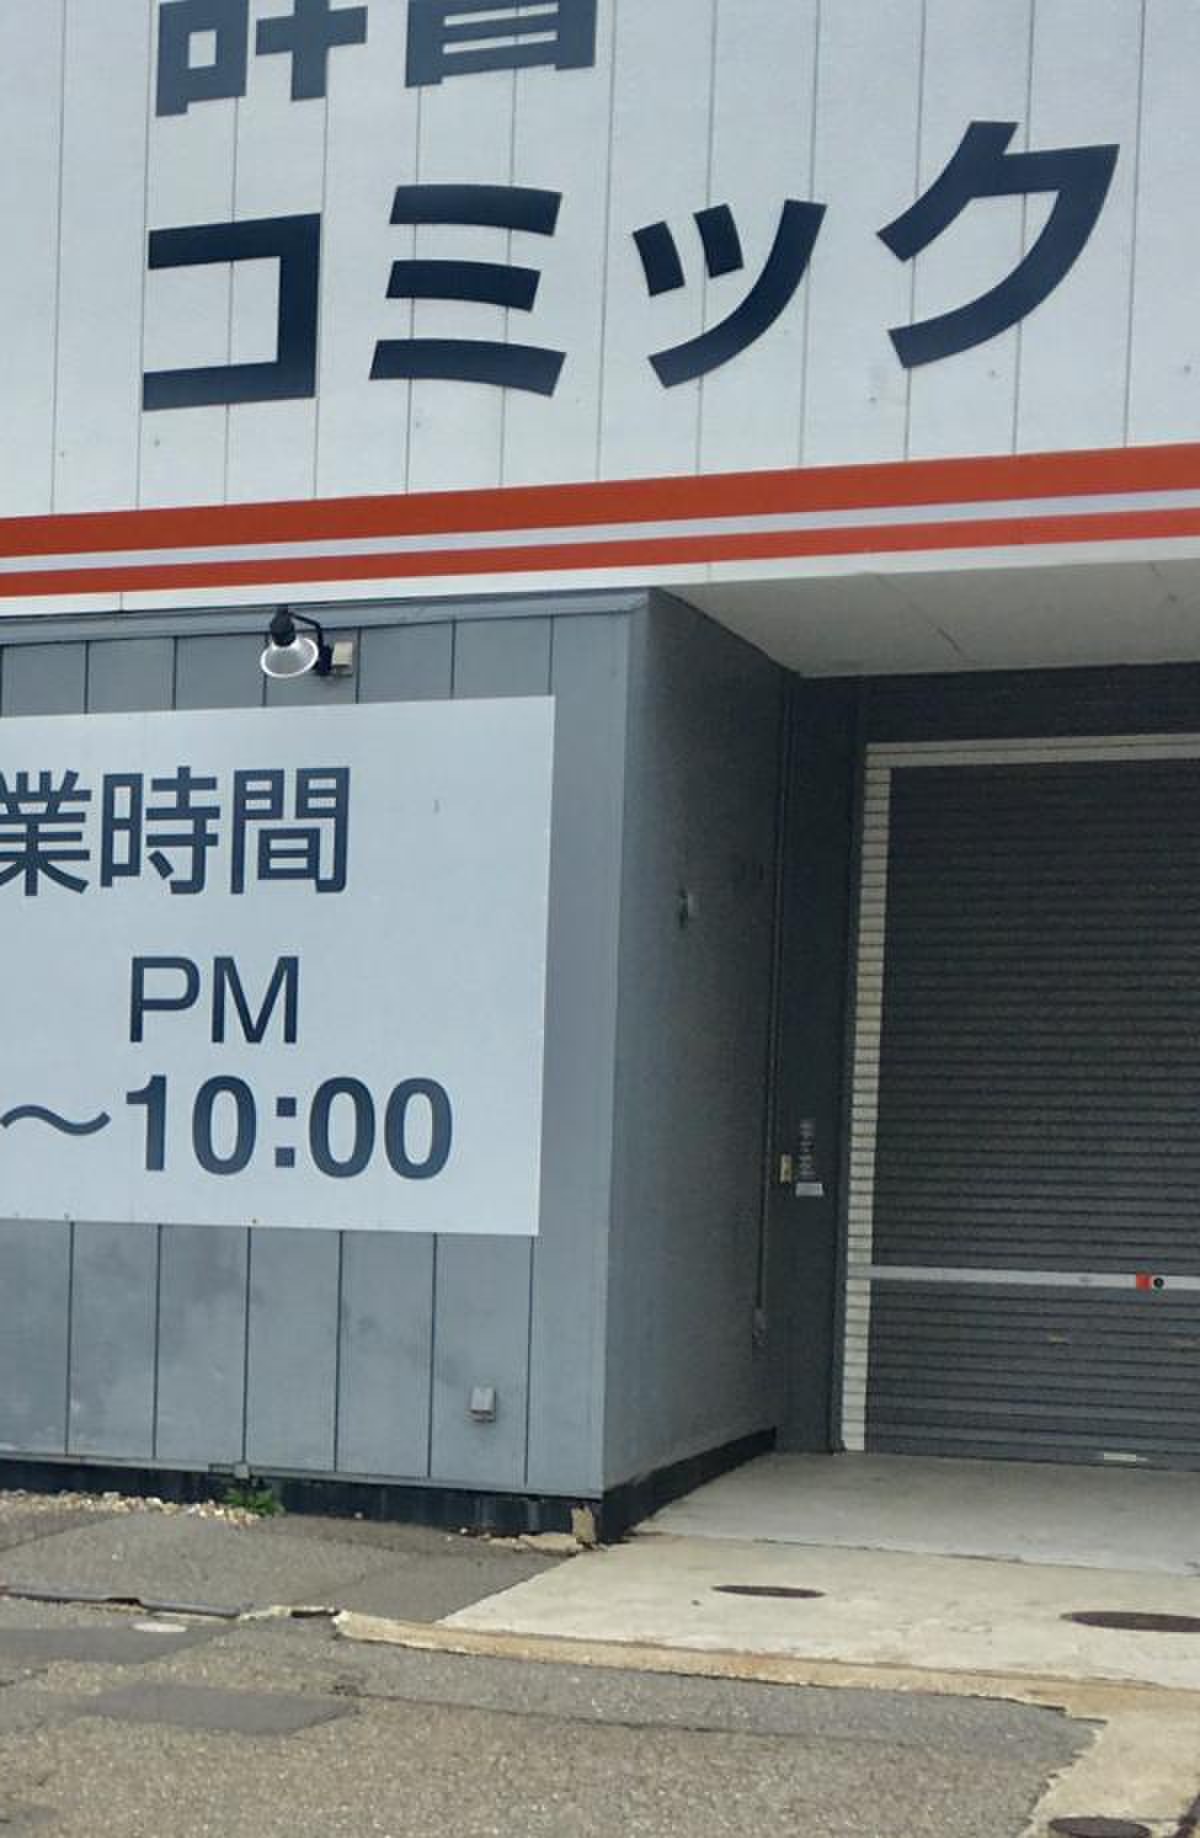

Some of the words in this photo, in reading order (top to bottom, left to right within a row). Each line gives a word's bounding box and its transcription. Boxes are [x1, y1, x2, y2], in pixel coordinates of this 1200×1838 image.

[142, 120, 1120, 411] コミック
[129, 956, 300, 1044] PM
